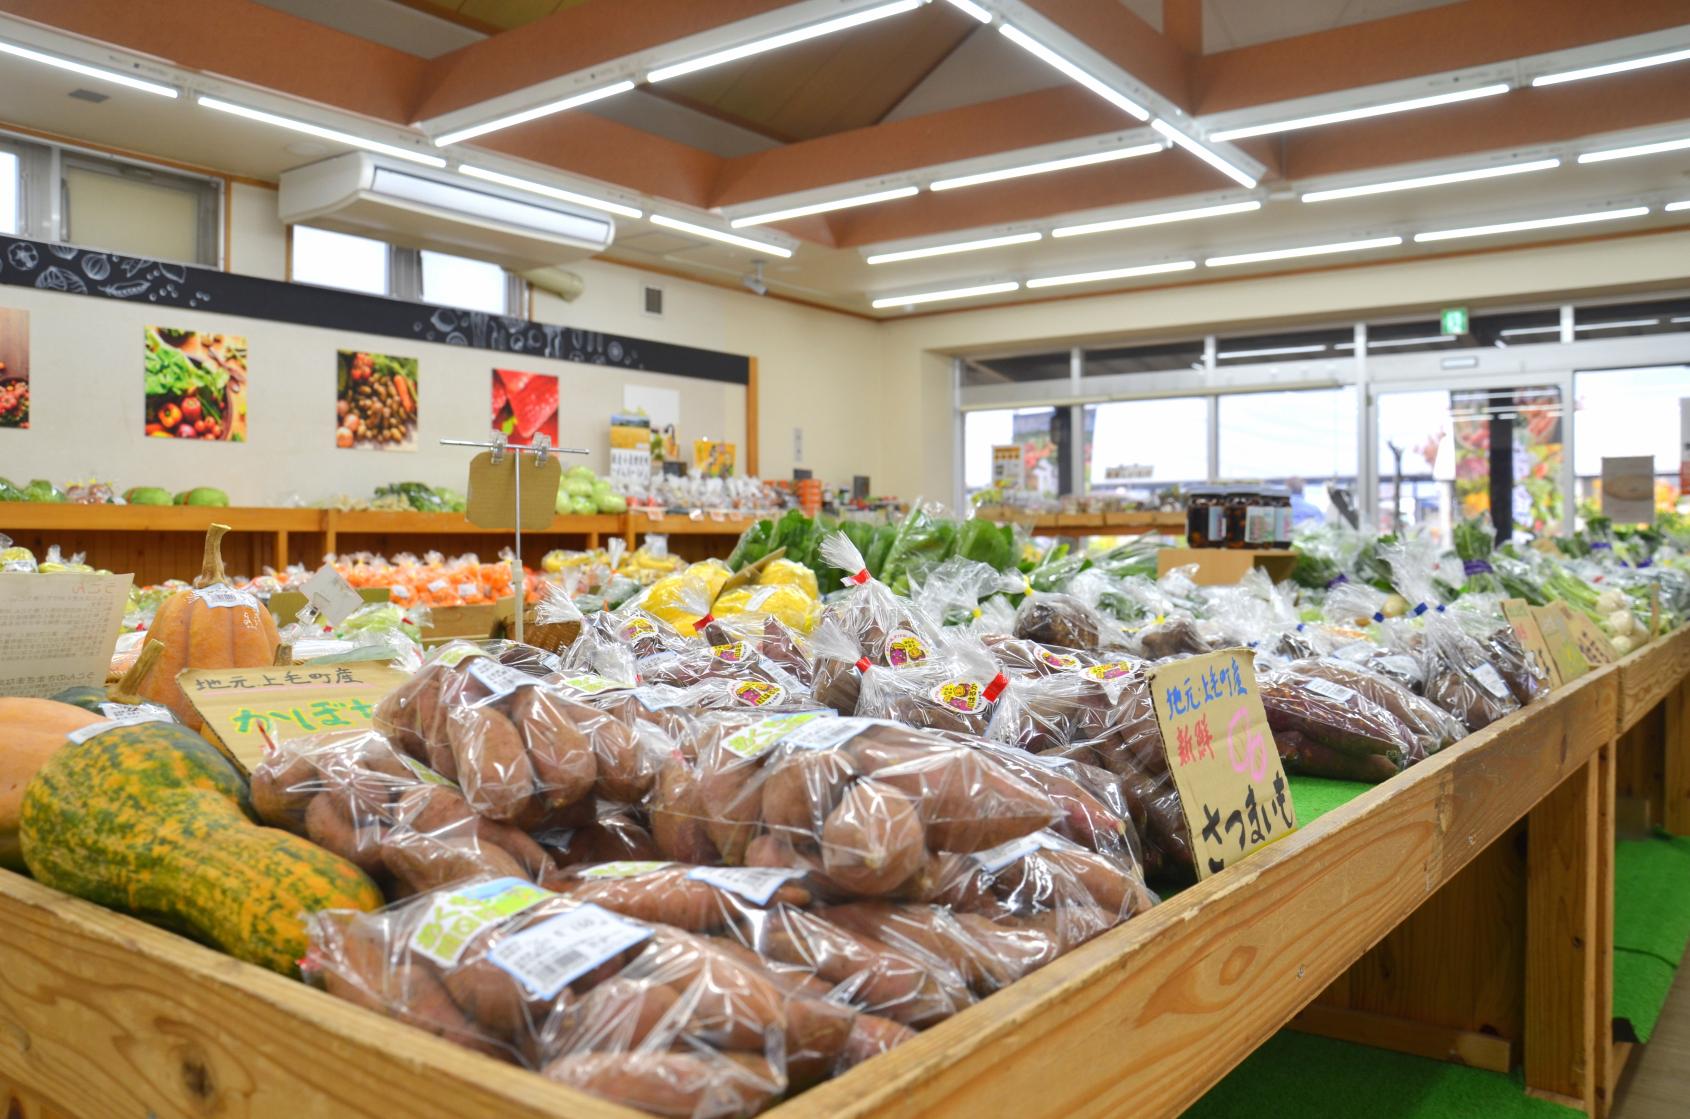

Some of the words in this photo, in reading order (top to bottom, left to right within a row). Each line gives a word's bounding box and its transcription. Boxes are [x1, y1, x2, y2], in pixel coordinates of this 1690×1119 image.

[196, 667, 364, 691] 地元上毛町産
[1176, 712, 1216, 767] 新鮮
[1201, 770, 1293, 874] さつまいも
